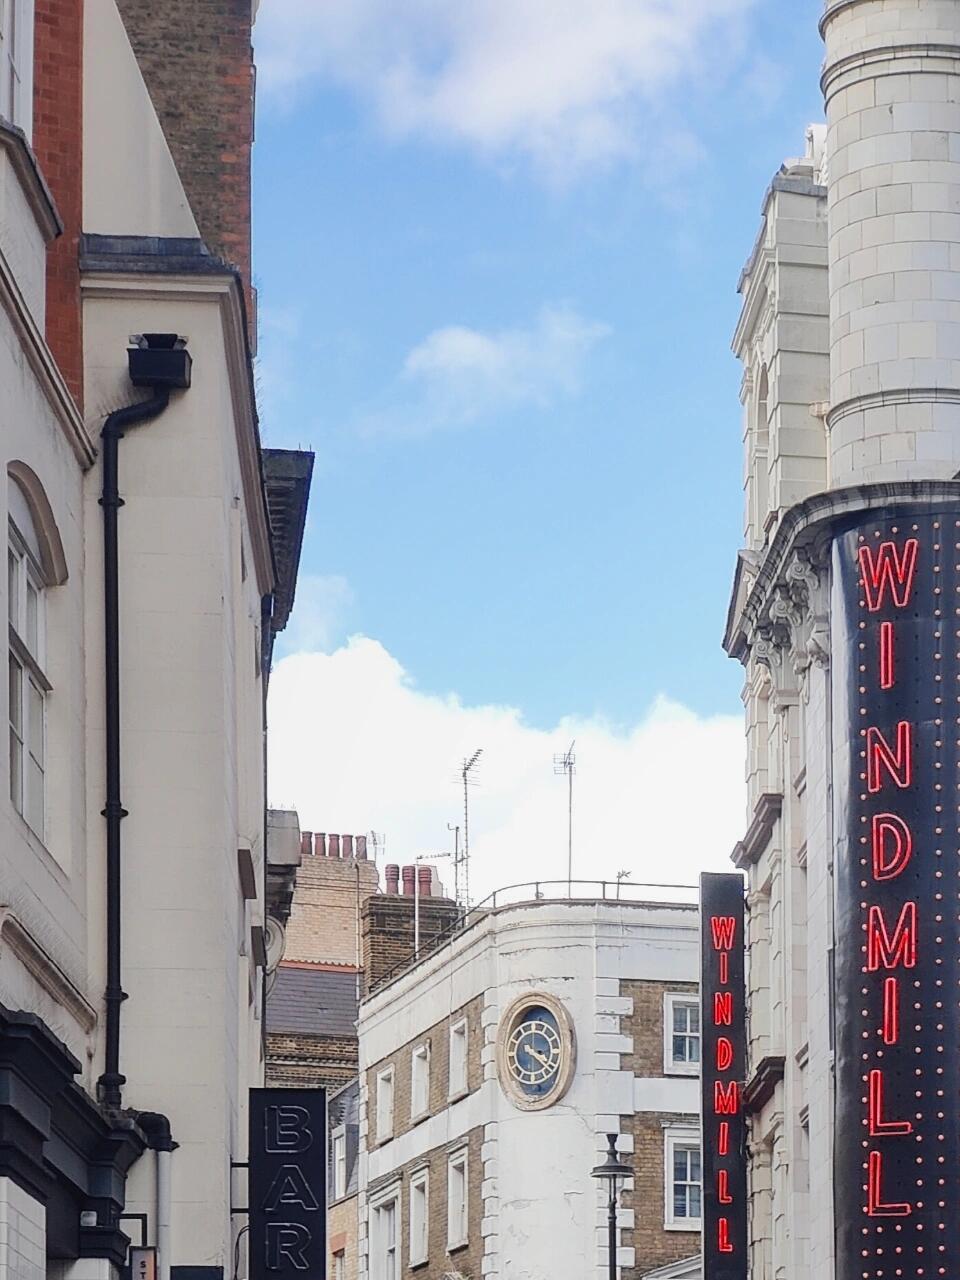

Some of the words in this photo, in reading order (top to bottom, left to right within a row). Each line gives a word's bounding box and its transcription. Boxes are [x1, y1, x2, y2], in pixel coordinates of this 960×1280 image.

[857, 538, 919, 1218] WINDMILL
[261, 1105, 320, 1269] BAR
[710, 916, 738, 1253] WINDMILL
